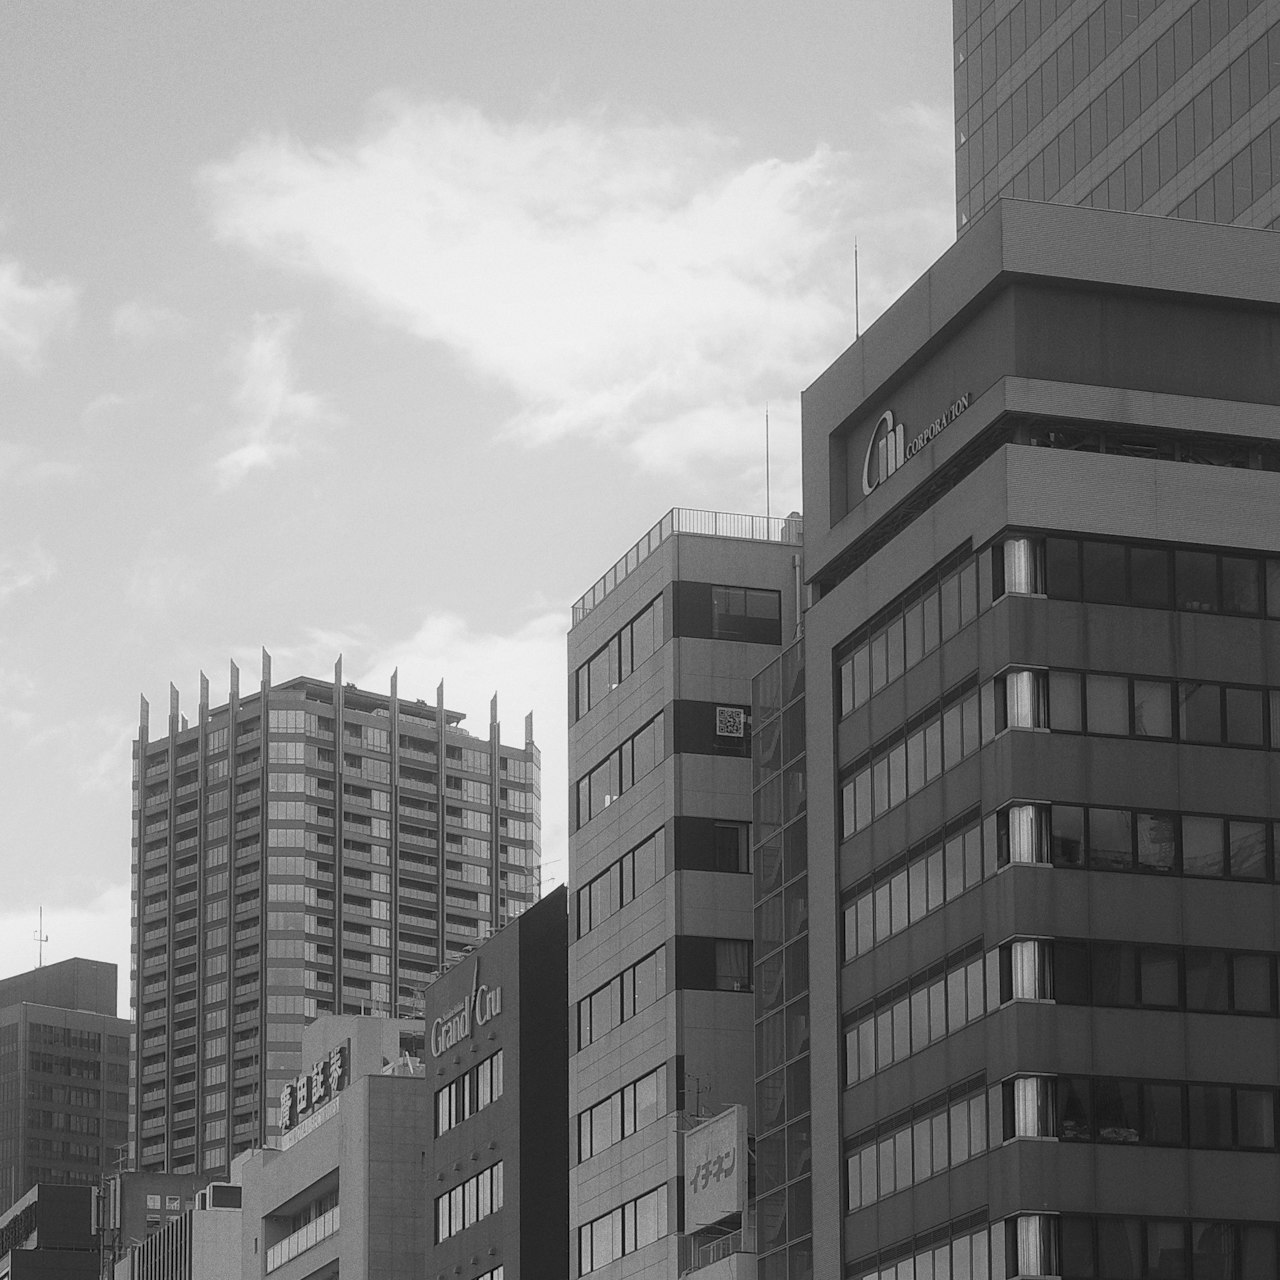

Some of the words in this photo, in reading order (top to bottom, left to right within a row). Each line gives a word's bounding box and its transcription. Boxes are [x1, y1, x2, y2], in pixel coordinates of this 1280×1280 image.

[430, 995, 470, 1058] Grand
[475, 984, 502, 1026] Cru
[690, 1147, 736, 1194] イチネン
